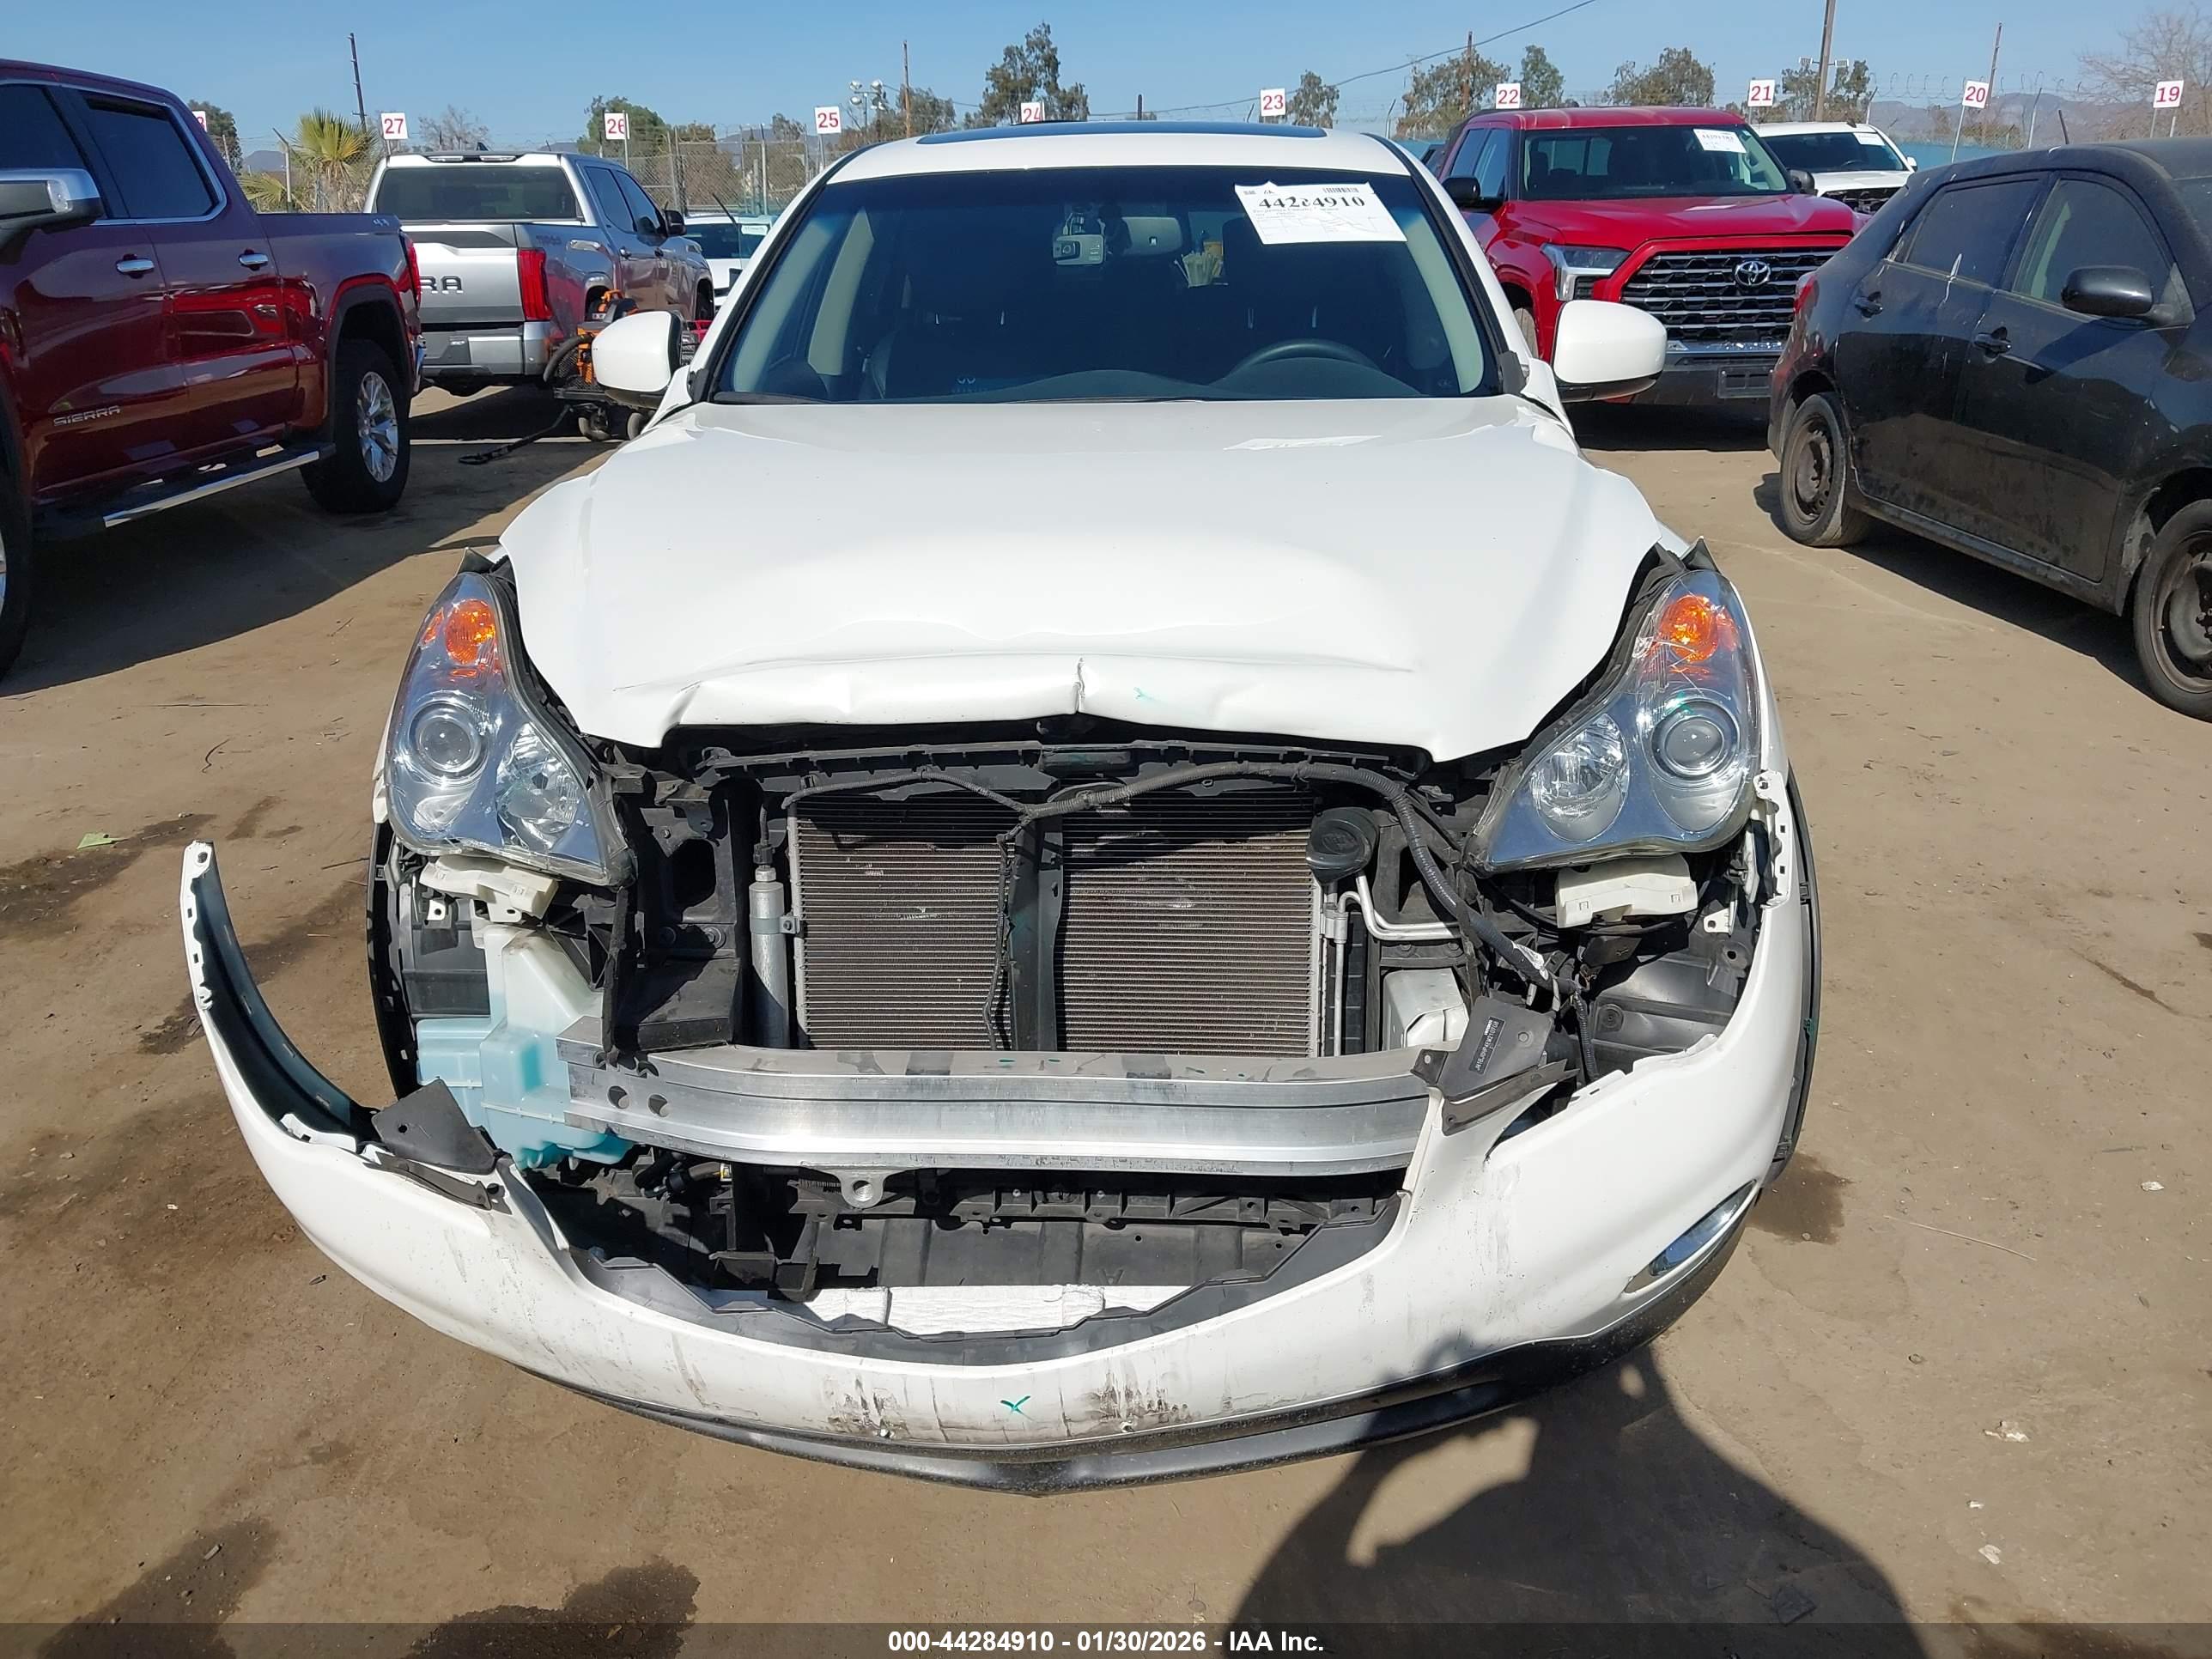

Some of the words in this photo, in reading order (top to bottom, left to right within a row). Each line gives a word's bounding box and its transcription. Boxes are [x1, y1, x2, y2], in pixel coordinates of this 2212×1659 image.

[1498, 89, 1519, 105] 22
[1751, 85, 1771, 101] 21
[1966, 85, 1986, 103] 20
[2156, 86, 2180, 102] 19
[1263, 94, 1284, 110] 23
[384, 118, 404, 134] 27
[817, 112, 839, 128] 25
[53, 404, 120, 427] SIERRA
